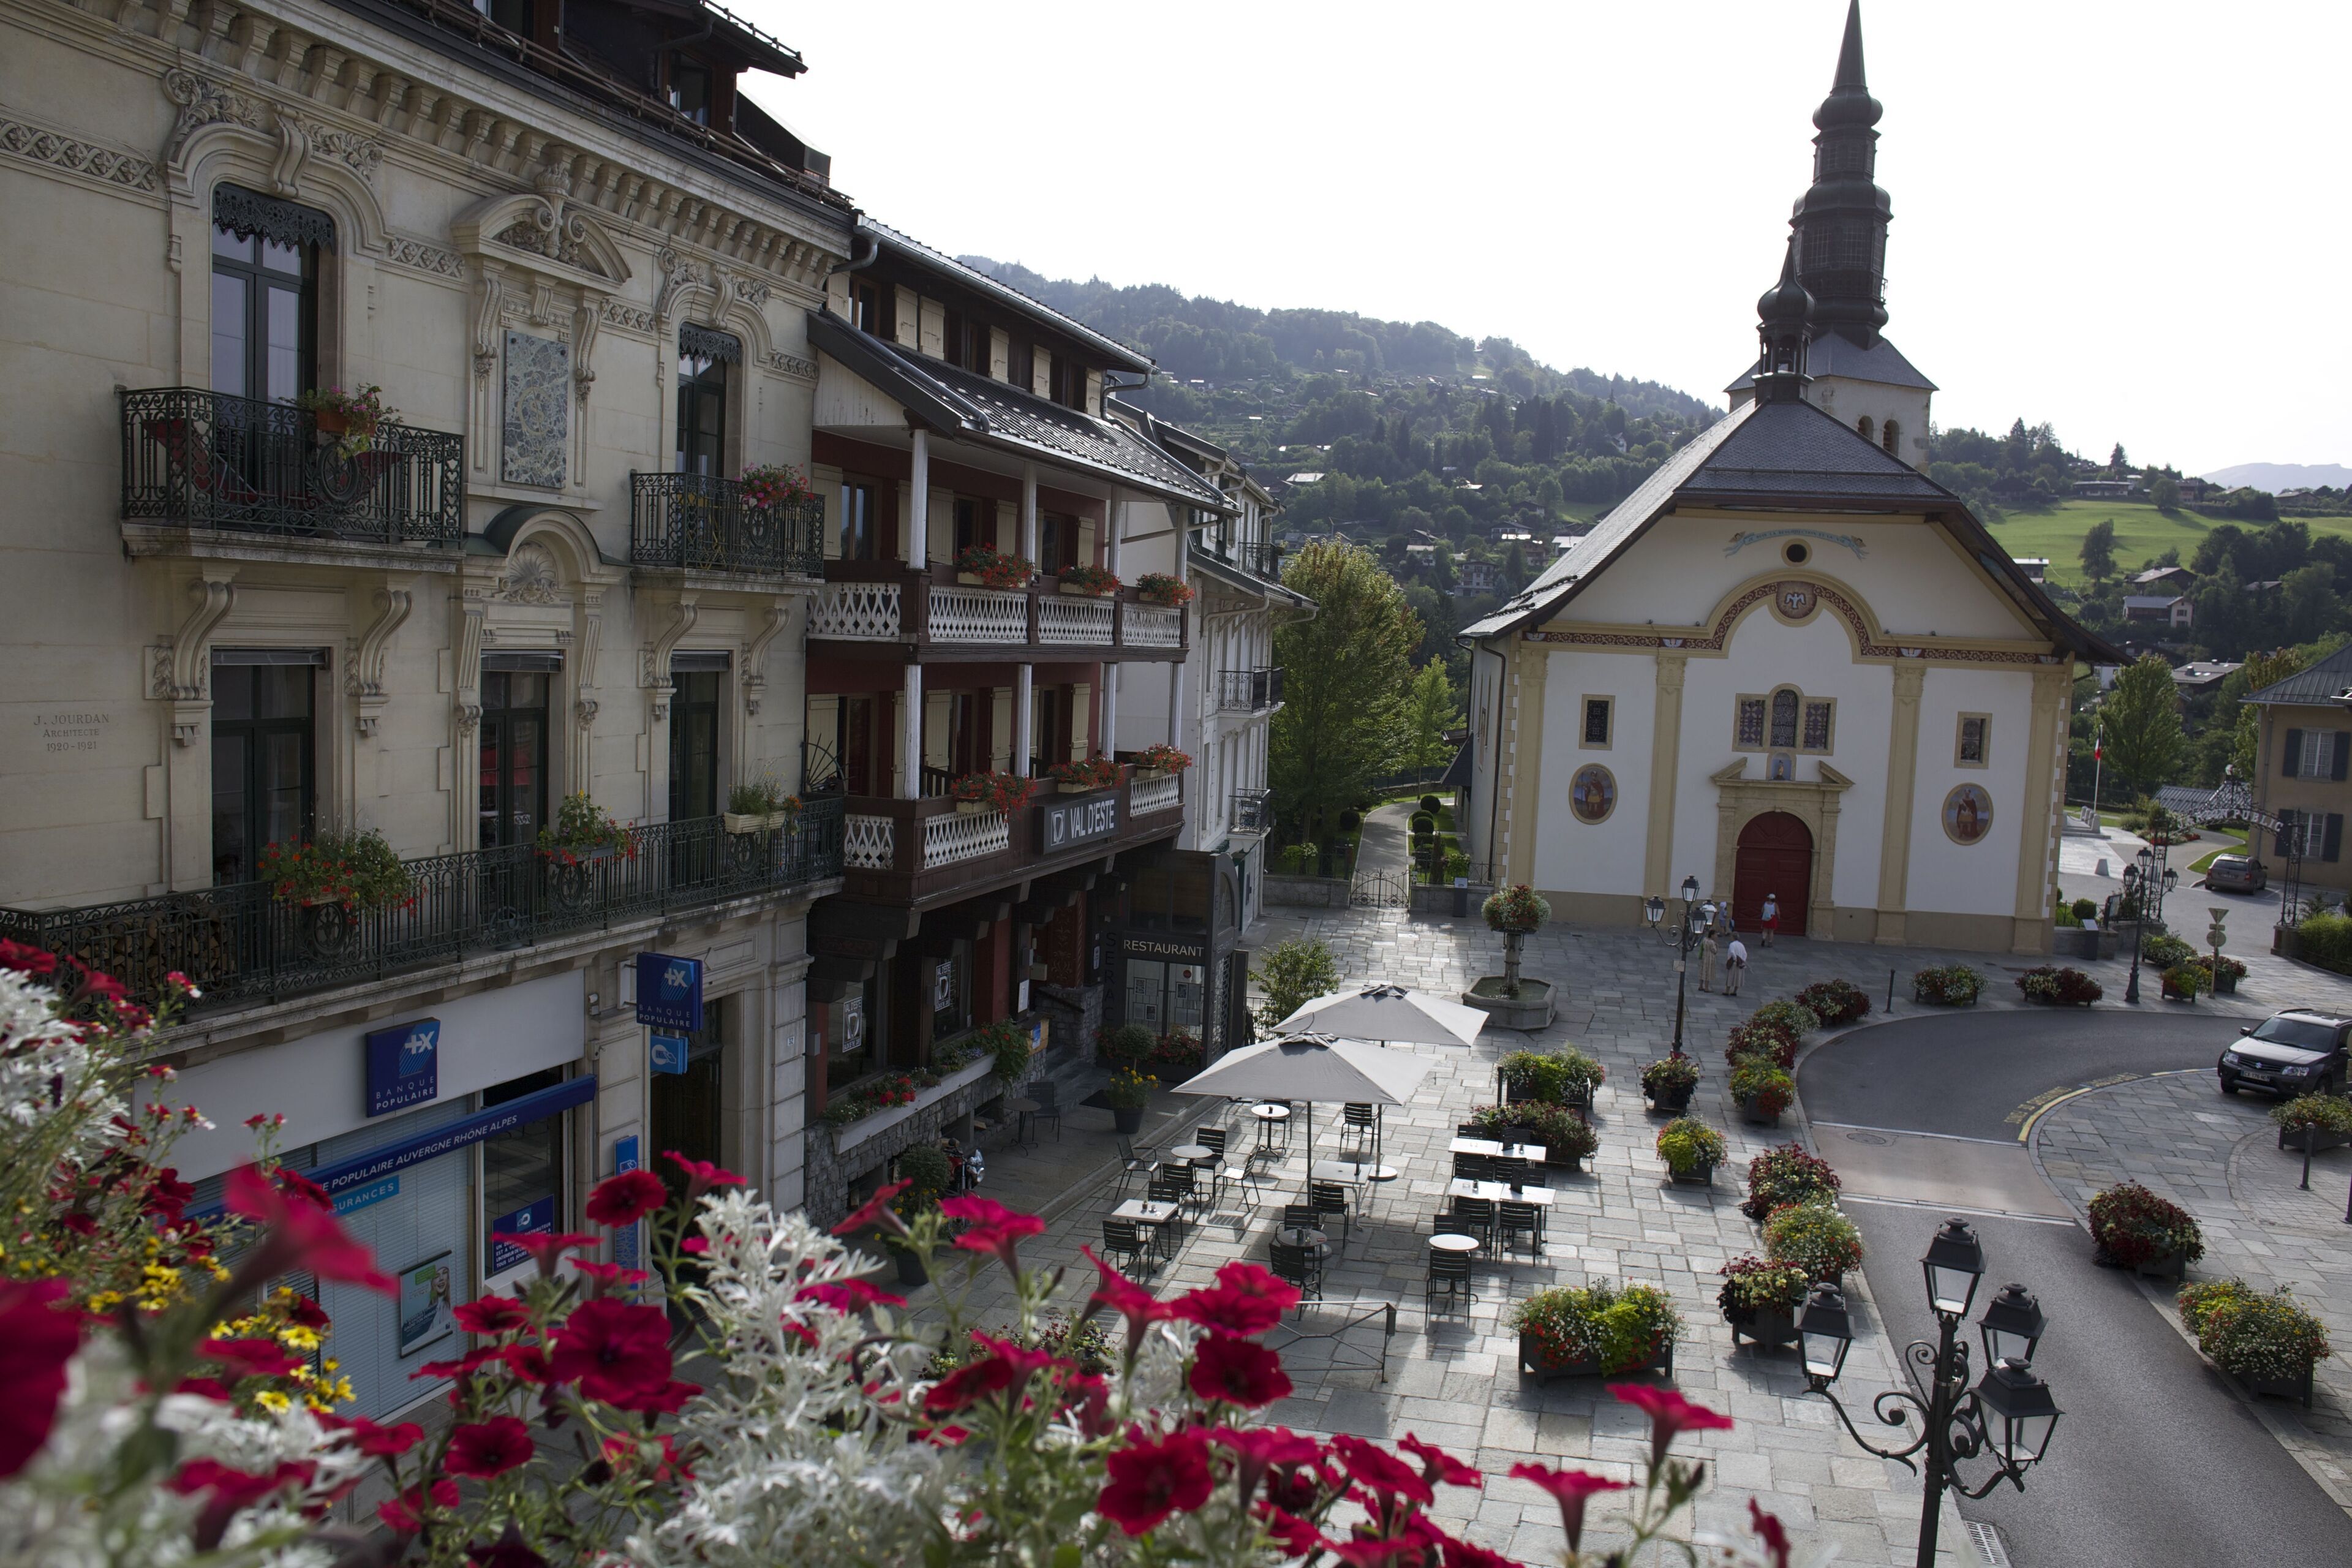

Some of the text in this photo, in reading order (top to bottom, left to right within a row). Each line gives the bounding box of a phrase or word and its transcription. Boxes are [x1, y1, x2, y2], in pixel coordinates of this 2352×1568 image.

[34, 714, 109, 725] J. JOURDAN
[43, 729, 100, 737] ARCHITECTE
[1070, 805, 1086, 839] VAL
[1087, 799, 1115, 834] D'ESTE
[2233, 809, 2284, 832] PUBLIC
[1123, 939, 1205, 957] RESTAURANT
[639, 1005, 690, 1018] BANQUE
[639, 1014, 690, 1027] POPULAIRE
[376, 1076, 434, 1099] BANQUE
[376, 1087, 434, 1110] POPULAIRE
[332, 1115, 518, 1189] POPULAIRE AUVERGNE RHÔNE ALPES
